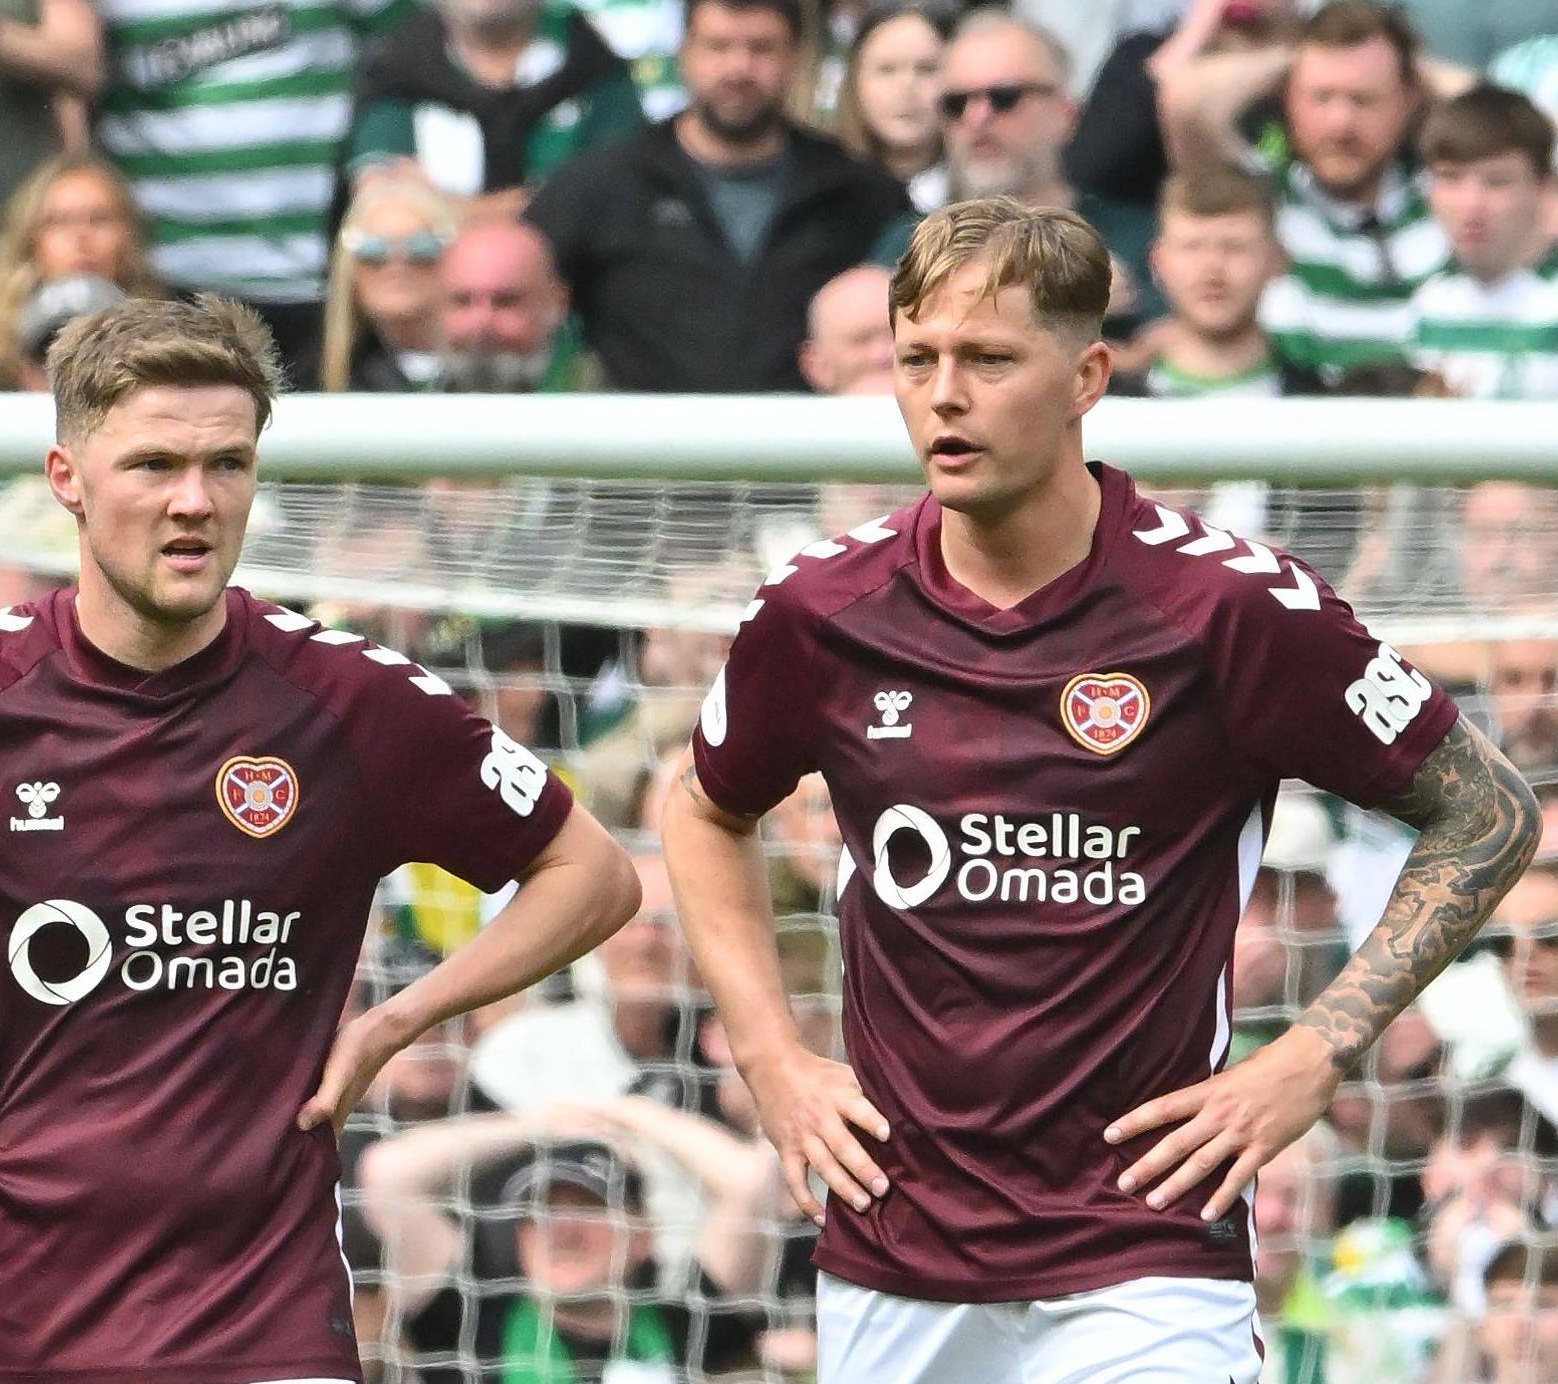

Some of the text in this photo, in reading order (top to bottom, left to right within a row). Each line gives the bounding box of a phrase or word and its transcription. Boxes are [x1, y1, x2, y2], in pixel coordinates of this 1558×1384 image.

[960, 813, 1142, 859] Stellar
[957, 858, 1146, 906] Omada
[125, 900, 301, 947] Stellar
[121, 947, 299, 993] Omada
